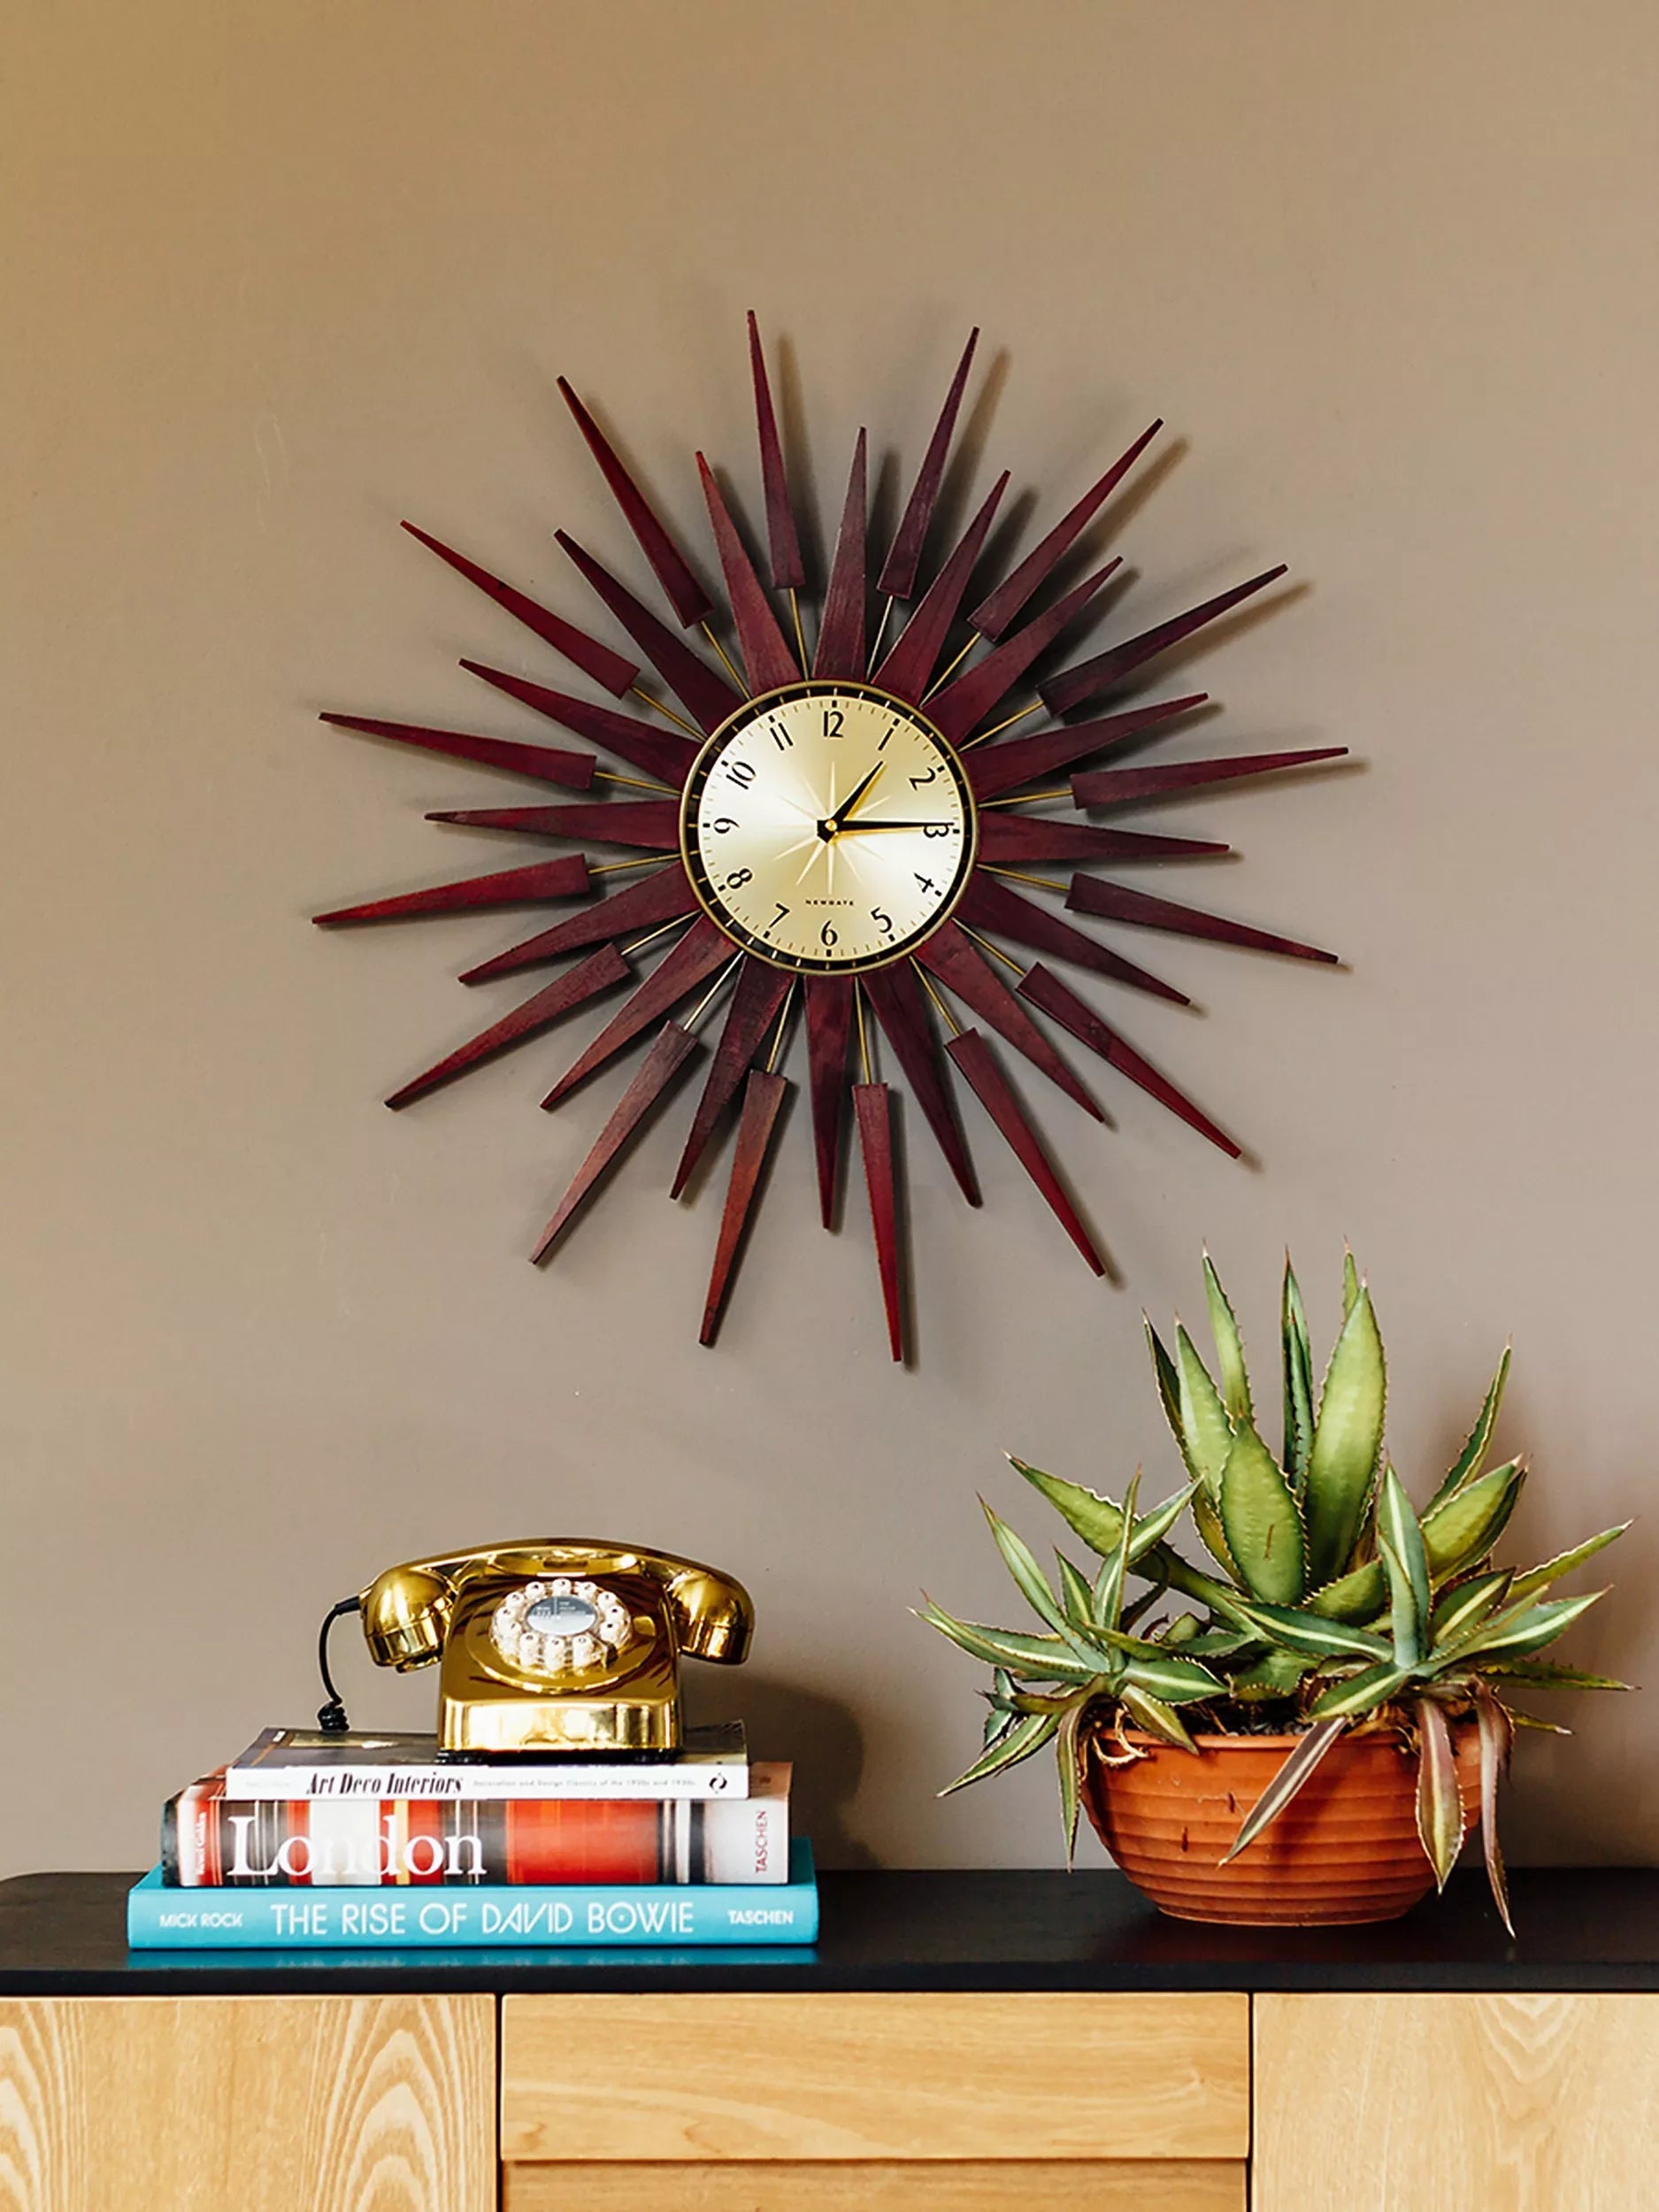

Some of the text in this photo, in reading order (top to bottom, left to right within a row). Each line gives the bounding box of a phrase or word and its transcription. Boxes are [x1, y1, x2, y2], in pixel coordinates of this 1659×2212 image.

[770, 721, 794, 751] 11
[823, 710, 845, 738] 12
[878, 727, 894, 751] 1
[726, 761, 757, 789] 10
[908, 767, 936, 791] 2
[713, 817, 741, 834] 9
[923, 821, 949, 839] 3
[726, 868, 754, 889] 8
[914, 872, 935, 894] 4
[768, 902, 791, 928] 7
[870, 907, 893, 934] 5
[820, 919, 839, 947] 6
[306, 1772, 335, 1794] Art
[340, 1772, 382, 1794] Deco
[387, 1770, 464, 1794] Interiors
[226, 1814, 488, 1877] London
[754, 1809, 768, 1874] TASCHEN
[159, 1912, 243, 1928] MICK ROCK
[269, 1901, 695, 1935] THE RISE OF DAVID BOWIE
[727, 1909, 794, 1925] TASCHEN
